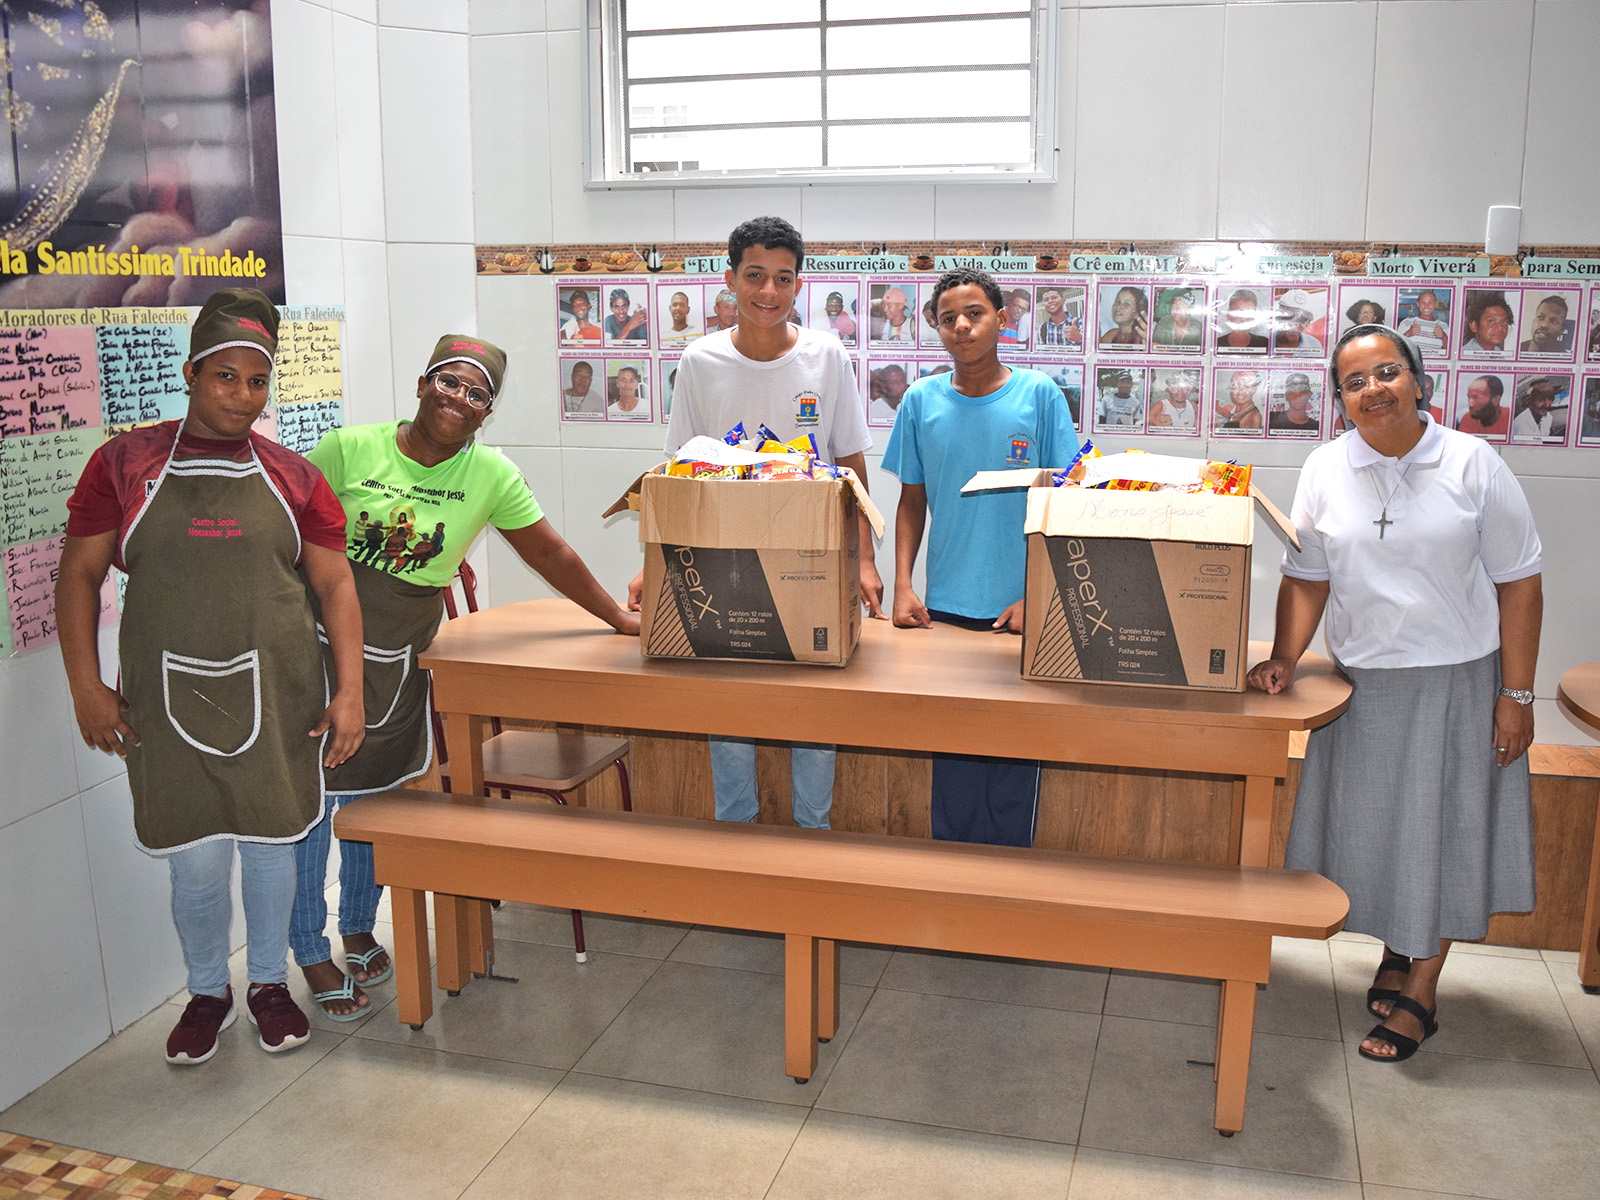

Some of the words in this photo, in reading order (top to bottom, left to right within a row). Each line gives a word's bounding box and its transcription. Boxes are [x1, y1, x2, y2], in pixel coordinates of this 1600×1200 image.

[0, 240, 28, 275] la
[37, 241, 174, 276] Santíssima
[178, 246, 267, 278] Trindade
[806, 257, 896, 275] Ressurreição
[899, 261, 907, 271] e
[937, 259, 947, 270] A
[952, 258, 987, 271] Vida.
[990, 258, 1029, 272] Quem
[1072, 256, 1101, 271] Crê
[1105, 260, 1126, 271] em
[1285, 259, 1324, 273] esteja
[1371, 261, 1414, 275] Morto
[1419, 258, 1477, 274] Viverá
[1527, 262, 1562, 276] para
[80, 309, 97, 325] de
[101, 309, 128, 325] Rua
[131, 308, 189, 325] Falecidos
[282, 306, 302, 321] Rua
[304, 306, 346, 322] Falecidos
[447, 488, 465, 503] Jessé
[1186, 593, 1228, 601] PROFESSIONAL
[1065, 587, 1092, 650] PROFESSIONAL
[744, 629, 767, 637] Simples
[1118, 647, 1135, 655] Folha
[1135, 648, 1159, 657] Simples
